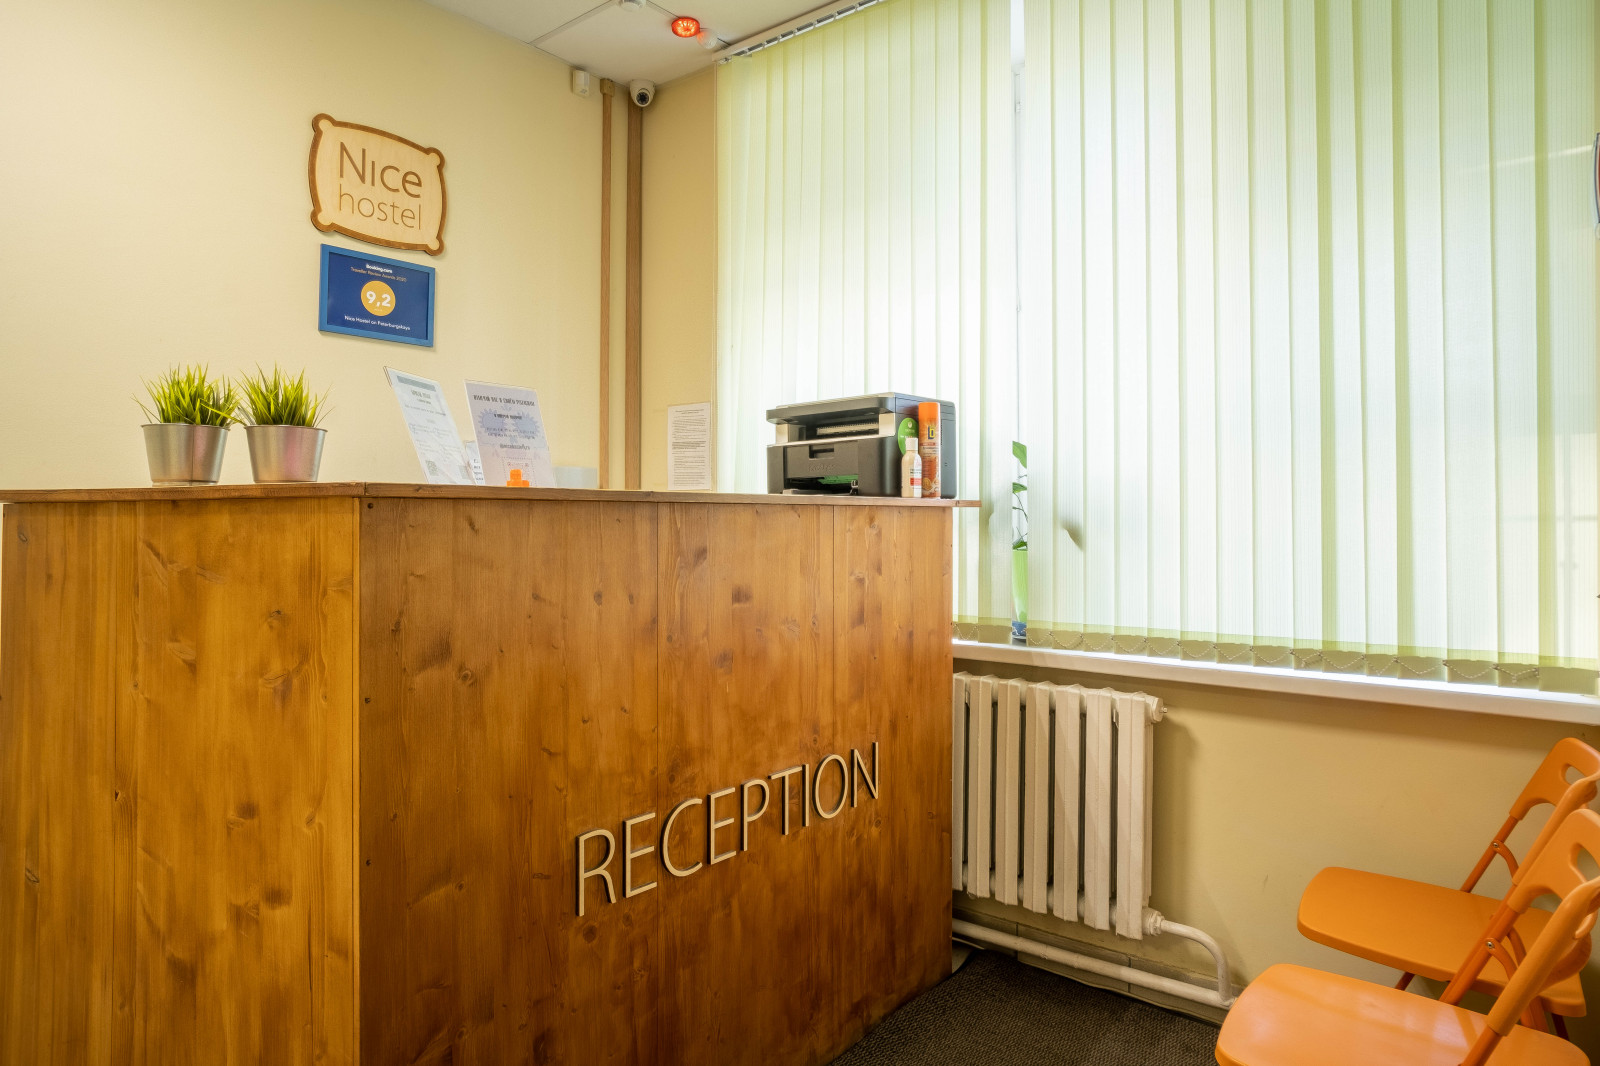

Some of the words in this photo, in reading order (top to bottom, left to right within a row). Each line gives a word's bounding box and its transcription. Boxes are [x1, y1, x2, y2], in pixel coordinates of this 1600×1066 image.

[340, 141, 422, 198] Nice
[339, 183, 421, 230] hostel
[365, 263, 393, 274] Booking.com
[366, 290, 391, 307] 9,2
[355, 316, 371, 324] Hostel
[575, 741, 879, 917] RECEPTION
